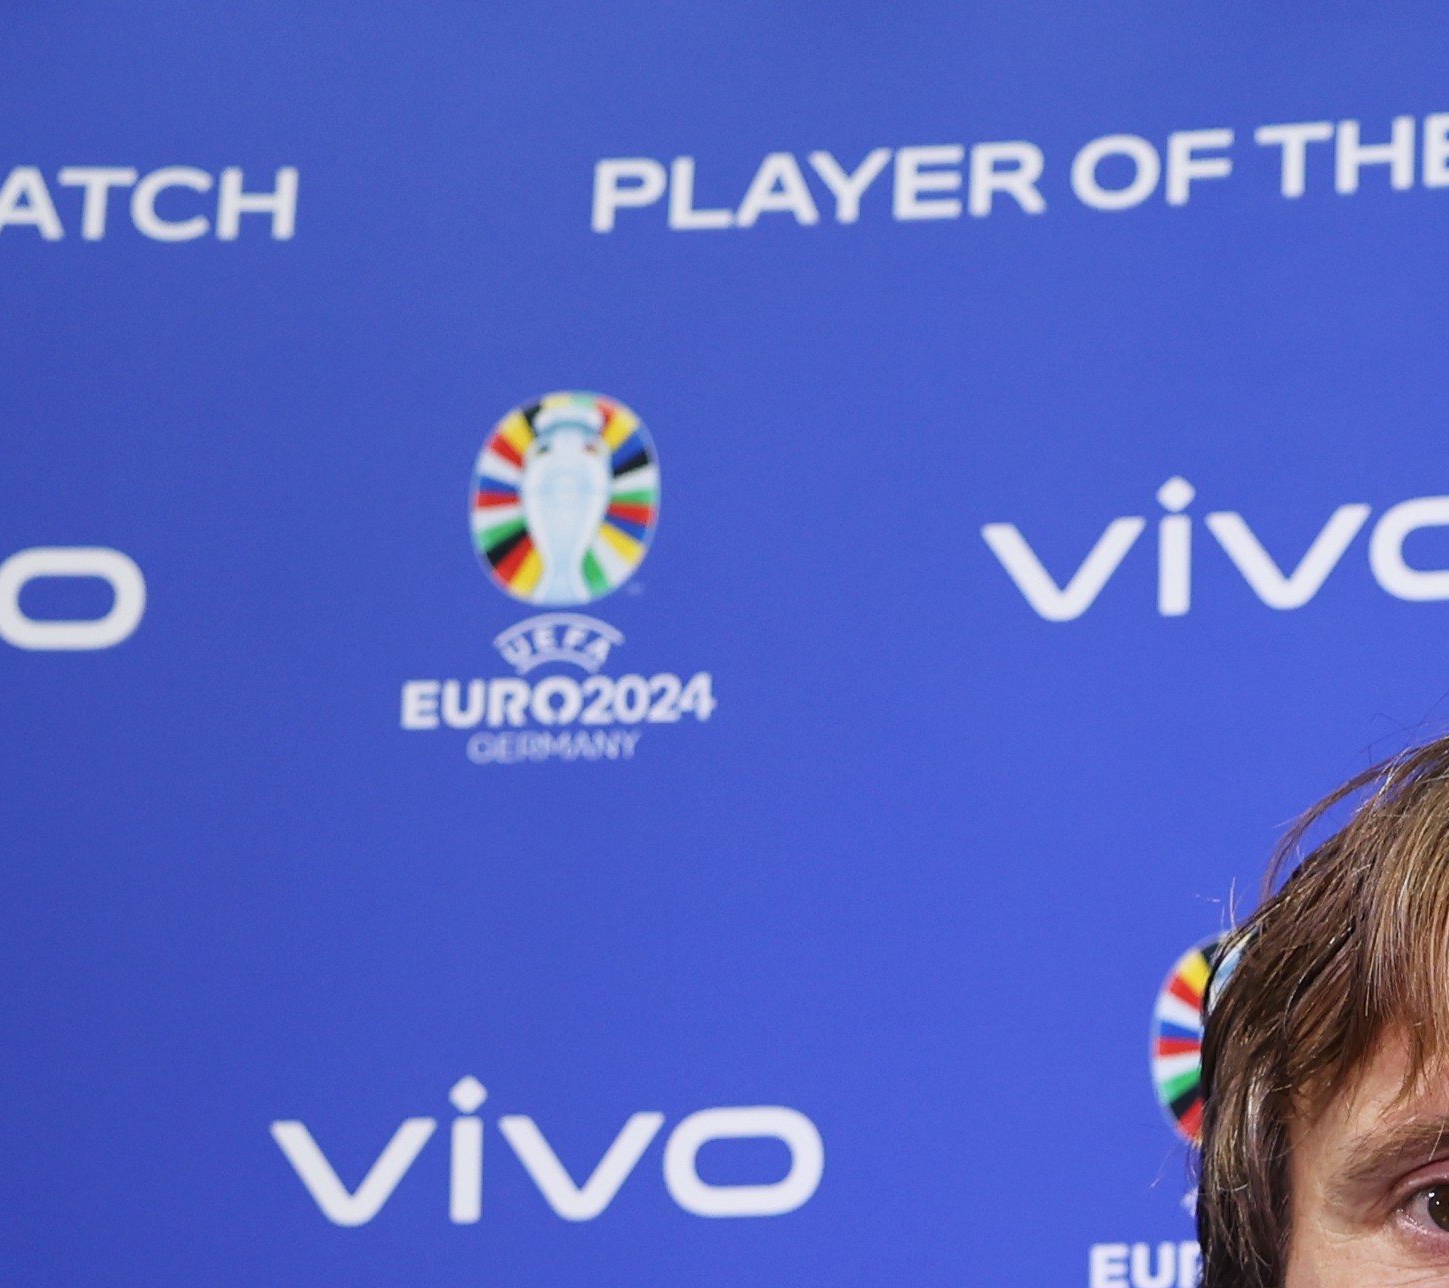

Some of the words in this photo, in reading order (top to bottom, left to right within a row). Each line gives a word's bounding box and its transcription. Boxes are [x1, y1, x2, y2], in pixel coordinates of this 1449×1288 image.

[591, 140, 1047, 233] PLAYER
[1070, 128, 1235, 211] OF
[500, 625, 611, 668] UEFA
[466, 731, 642, 764] GERMANY
[270, 1076, 826, 1227] vivo
